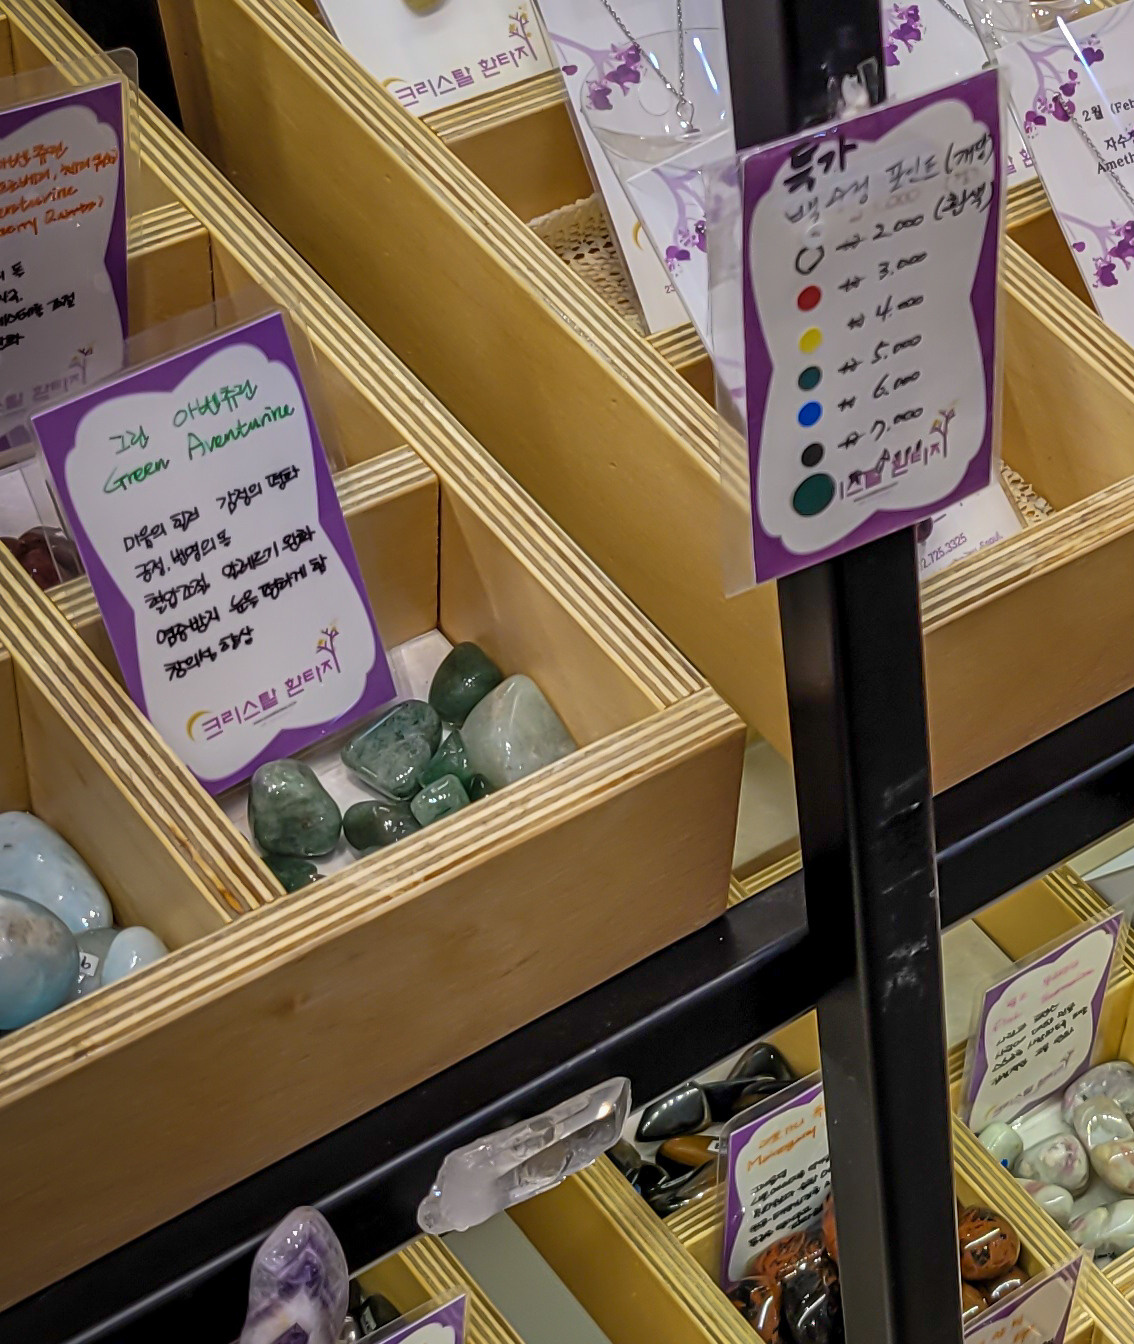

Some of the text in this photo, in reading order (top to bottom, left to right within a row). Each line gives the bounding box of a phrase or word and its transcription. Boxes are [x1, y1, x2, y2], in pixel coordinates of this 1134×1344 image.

[394, 44, 538, 108] 크리스탈 환타지
[1081, 105, 1104, 123] 2월
[783, 134, 859, 194] 특가
[103, 404, 295, 494] Green Aventurine
[109, 425, 150, 455] 그린
[123, 522, 167, 552] 마음의
[216, 482, 263, 515] 감정의
[201, 658, 341, 741] 크리스탈 환타지
